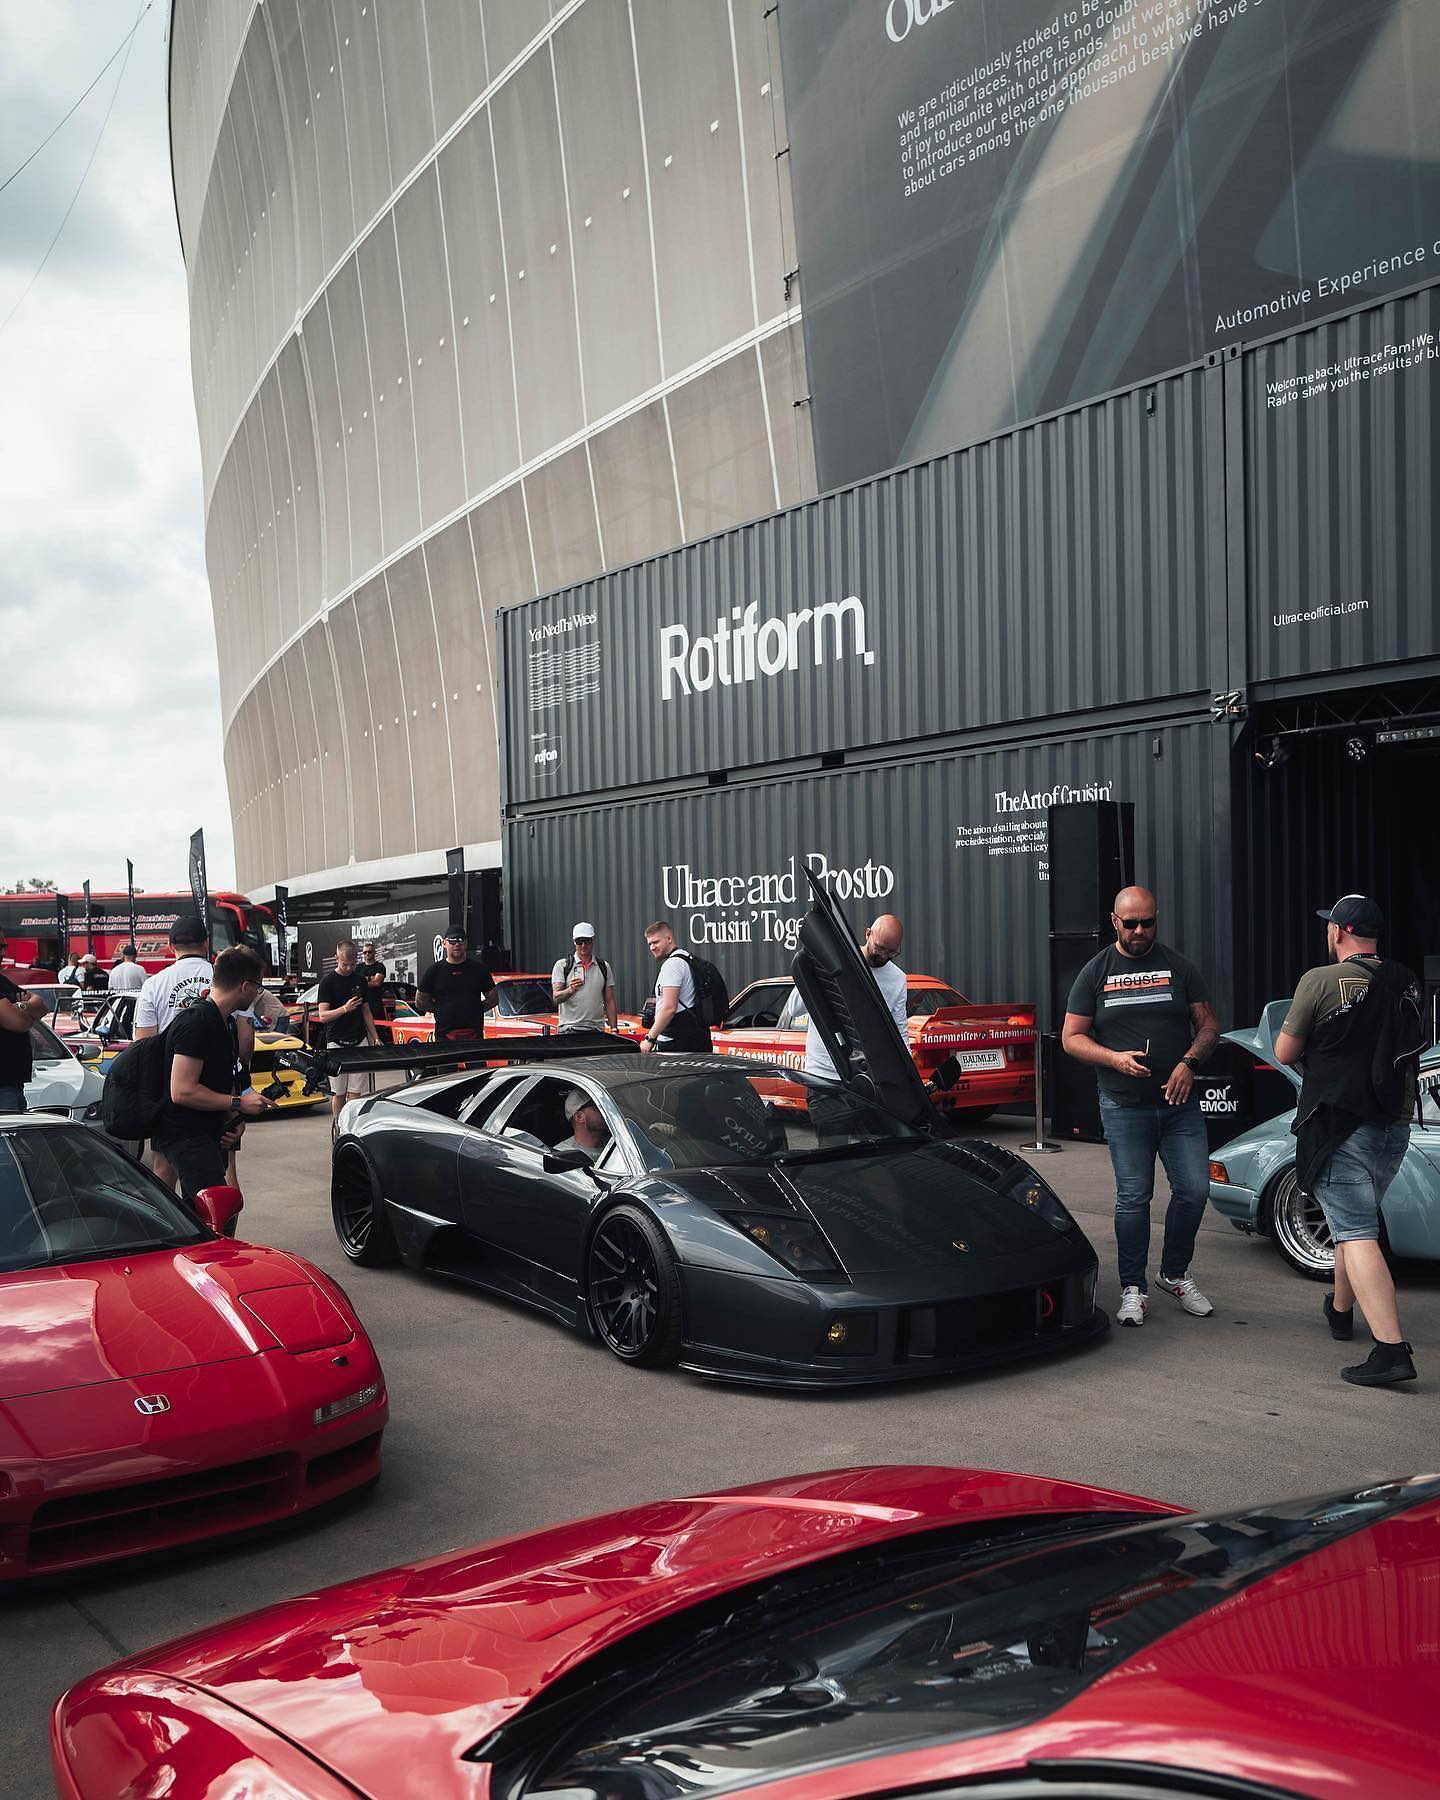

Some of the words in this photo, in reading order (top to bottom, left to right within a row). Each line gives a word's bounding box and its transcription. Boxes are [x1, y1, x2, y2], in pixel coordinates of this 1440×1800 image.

[897, 111, 916, 129] We
[918, 98, 937, 117] are
[940, 51, 1012, 103] ridiculously
[1015, 17, 1060, 58] stoked
[1064, 11, 1077, 27] to
[900, 125, 921, 146] and
[924, 94, 971, 133] familiar
[973, 74, 1012, 101] faces.
[1015, 45, 1053, 77] There
[1057, 35, 1070, 52] is
[1074, 23, 1091, 42] no
[901, 146, 914, 163] of
[915, 137, 932, 161] joy
[934, 129, 946, 144] to
[950, 103, 993, 135] reunite
[997, 82, 1023, 108] with
[1028, 64, 1048, 89] old
[1053, 37, 1108, 77] friends,
[1111, 15, 1137, 41] but
[1141, 2, 1163, 24] we
[903, 166, 914, 180] to
[917, 133, 972, 172] introduce
[976, 117, 998, 138] our
[1001, 83, 1057, 124] elevated
[1060, 42, 1128, 91] approach
[1133, 33, 1148, 49] to
[1152, 8, 1192, 39] what
[904, 170, 937, 197] about
[939, 154, 966, 177] cars
[969, 130, 1011, 161] among
[1014, 114, 1036, 136] the
[1040, 100, 1065, 122] one
[1068, 57, 1137, 105] thousand
[1142, 37, 1175, 67] best
[1179, 23, 1203, 45] we
[1208, 1, 1248, 30] have
[1215, 289, 1311, 333] Automotive
[1318, 247, 1425, 297] Experience
[1266, 372, 1314, 395] Welcome
[1315, 364, 1341, 380] back
[1383, 338, 1415, 358] Fam!
[1416, 333, 1434, 347] We
[1287, 391, 1298, 402] to
[1302, 381, 1328, 399] show
[1330, 377, 1350, 392] you
[1350, 369, 1370, 383] the
[1373, 357, 1412, 377] results
[1414, 352, 1424, 364] of
[1273, 600, 1369, 627] Ultraceofficial.com
[994, 790, 1020, 813] The
[1020, 789, 1042, 810] Art
[1042, 785, 1060, 808] of
[957, 826, 972, 836] The
[747, 855, 797, 905] and
[805, 853, 894, 902] Prosto
[690, 910, 758, 944] Cruisin'
[173, 977, 211, 993] DRIVERS
[1114, 974, 1160, 988] HOUSE
[1205, 1088, 1226, 1100] ON
